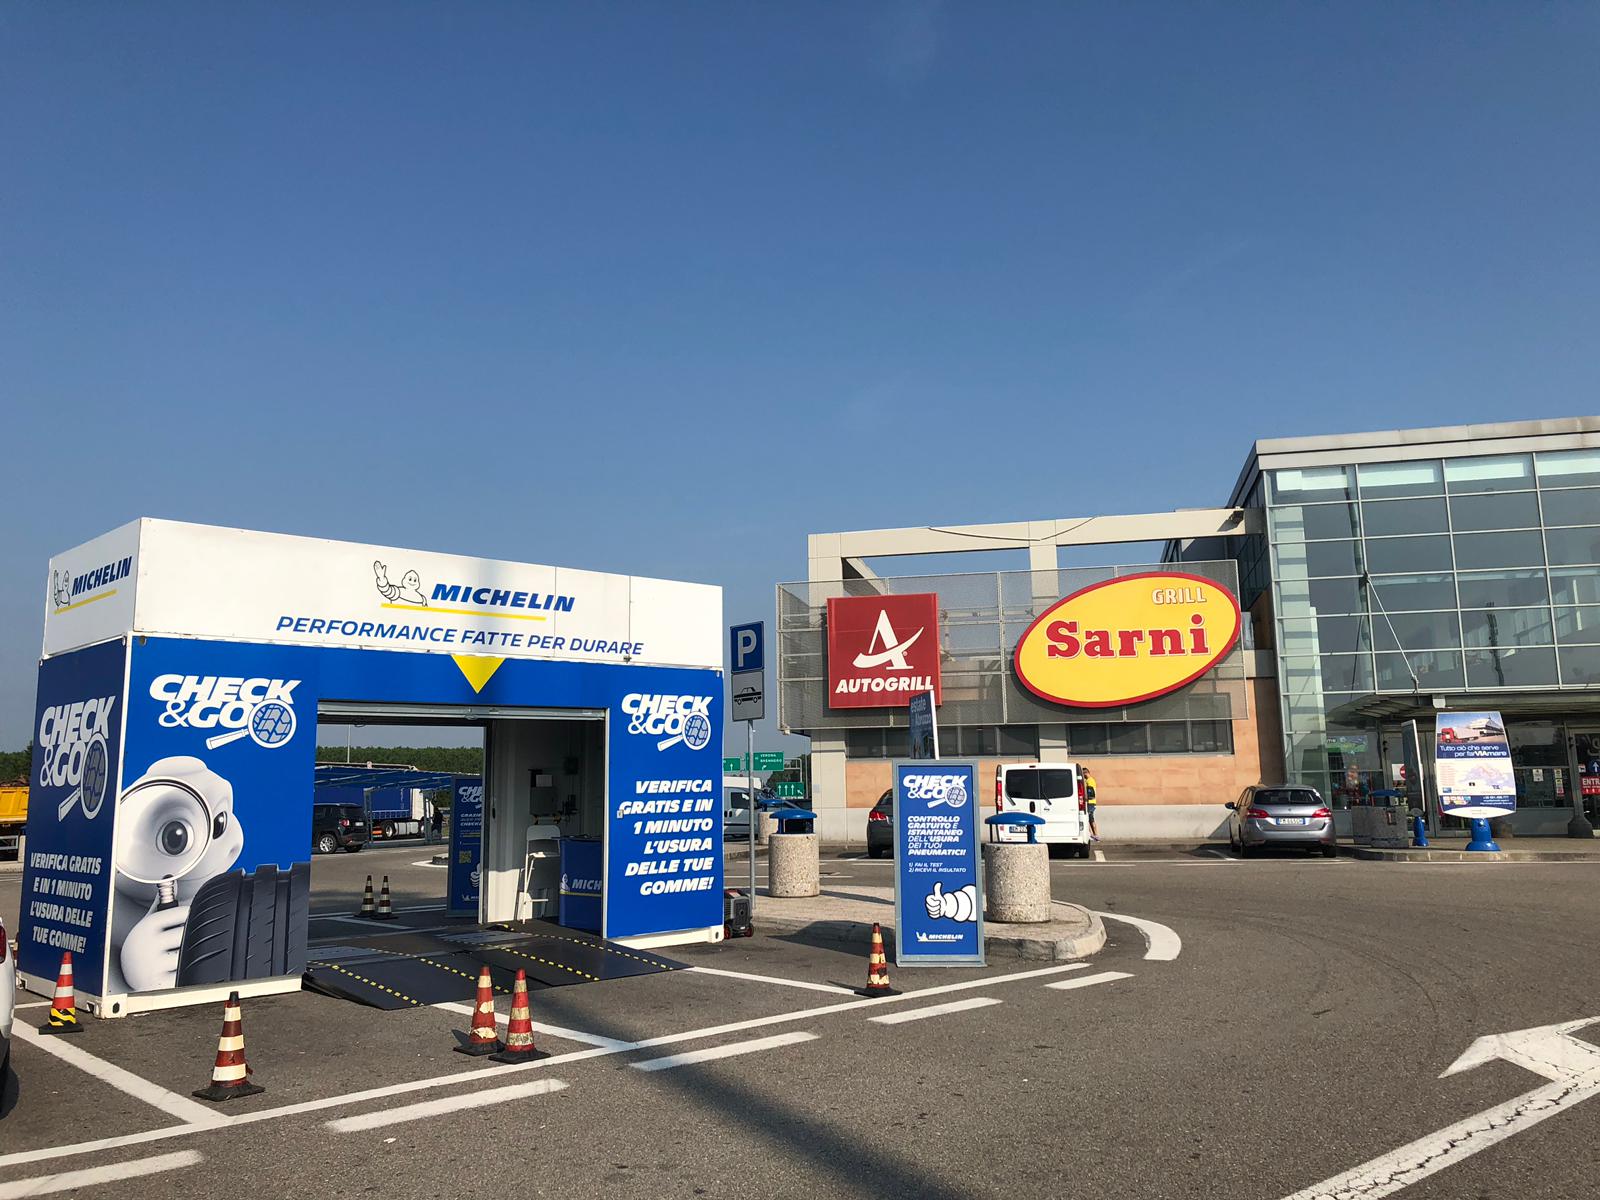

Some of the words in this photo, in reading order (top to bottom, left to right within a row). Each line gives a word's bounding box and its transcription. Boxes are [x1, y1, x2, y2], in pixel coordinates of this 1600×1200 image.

[71, 556, 132, 597] MICHELIN
[431, 583, 575, 612] MICHELIN
[1152, 587, 1207, 605] GRILL
[275, 615, 458, 643] PERFORMANCE
[461, 629, 524, 648] FATTE
[527, 634, 566, 651] PER
[569, 637, 644, 655] DURARE
[1045, 613, 1211, 659] Sarni
[737, 629, 757, 667] P
[149, 674, 302, 704] CHECK
[835, 676, 934, 693] AUTOGRILL
[159, 699, 254, 729] &GO
[621, 693, 714, 715] CHECK
[39, 696, 115, 748] CHECK
[628, 712, 684, 736] &GO
[635, 779, 713, 795] VERIFICA
[903, 775, 968, 788] CHECK
[621, 800, 679, 815] GRATIS
[682, 800, 693, 813] E
[695, 799, 714, 813] IN
[634, 821, 642, 834] 1
[645, 818, 714, 833] MINUTO
[907, 815, 960, 823] CONTROLLO
[644, 838, 713, 854] L'USURA
[30, 852, 68, 871] VERIFICA
[69, 855, 102, 875] GRATIS
[625, 860, 680, 876] DELLE
[683, 857, 714, 872] TUE
[33, 877, 40, 892] E
[39, 878, 51, 894] IN
[51, 879, 56, 895] 1
[56, 880, 92, 900] MINUTO
[640, 876, 714, 896] GOMME!
[65, 907, 93, 927] DELLE
[32, 926, 49, 944] TUE
[49, 929, 87, 953] GOMME!
